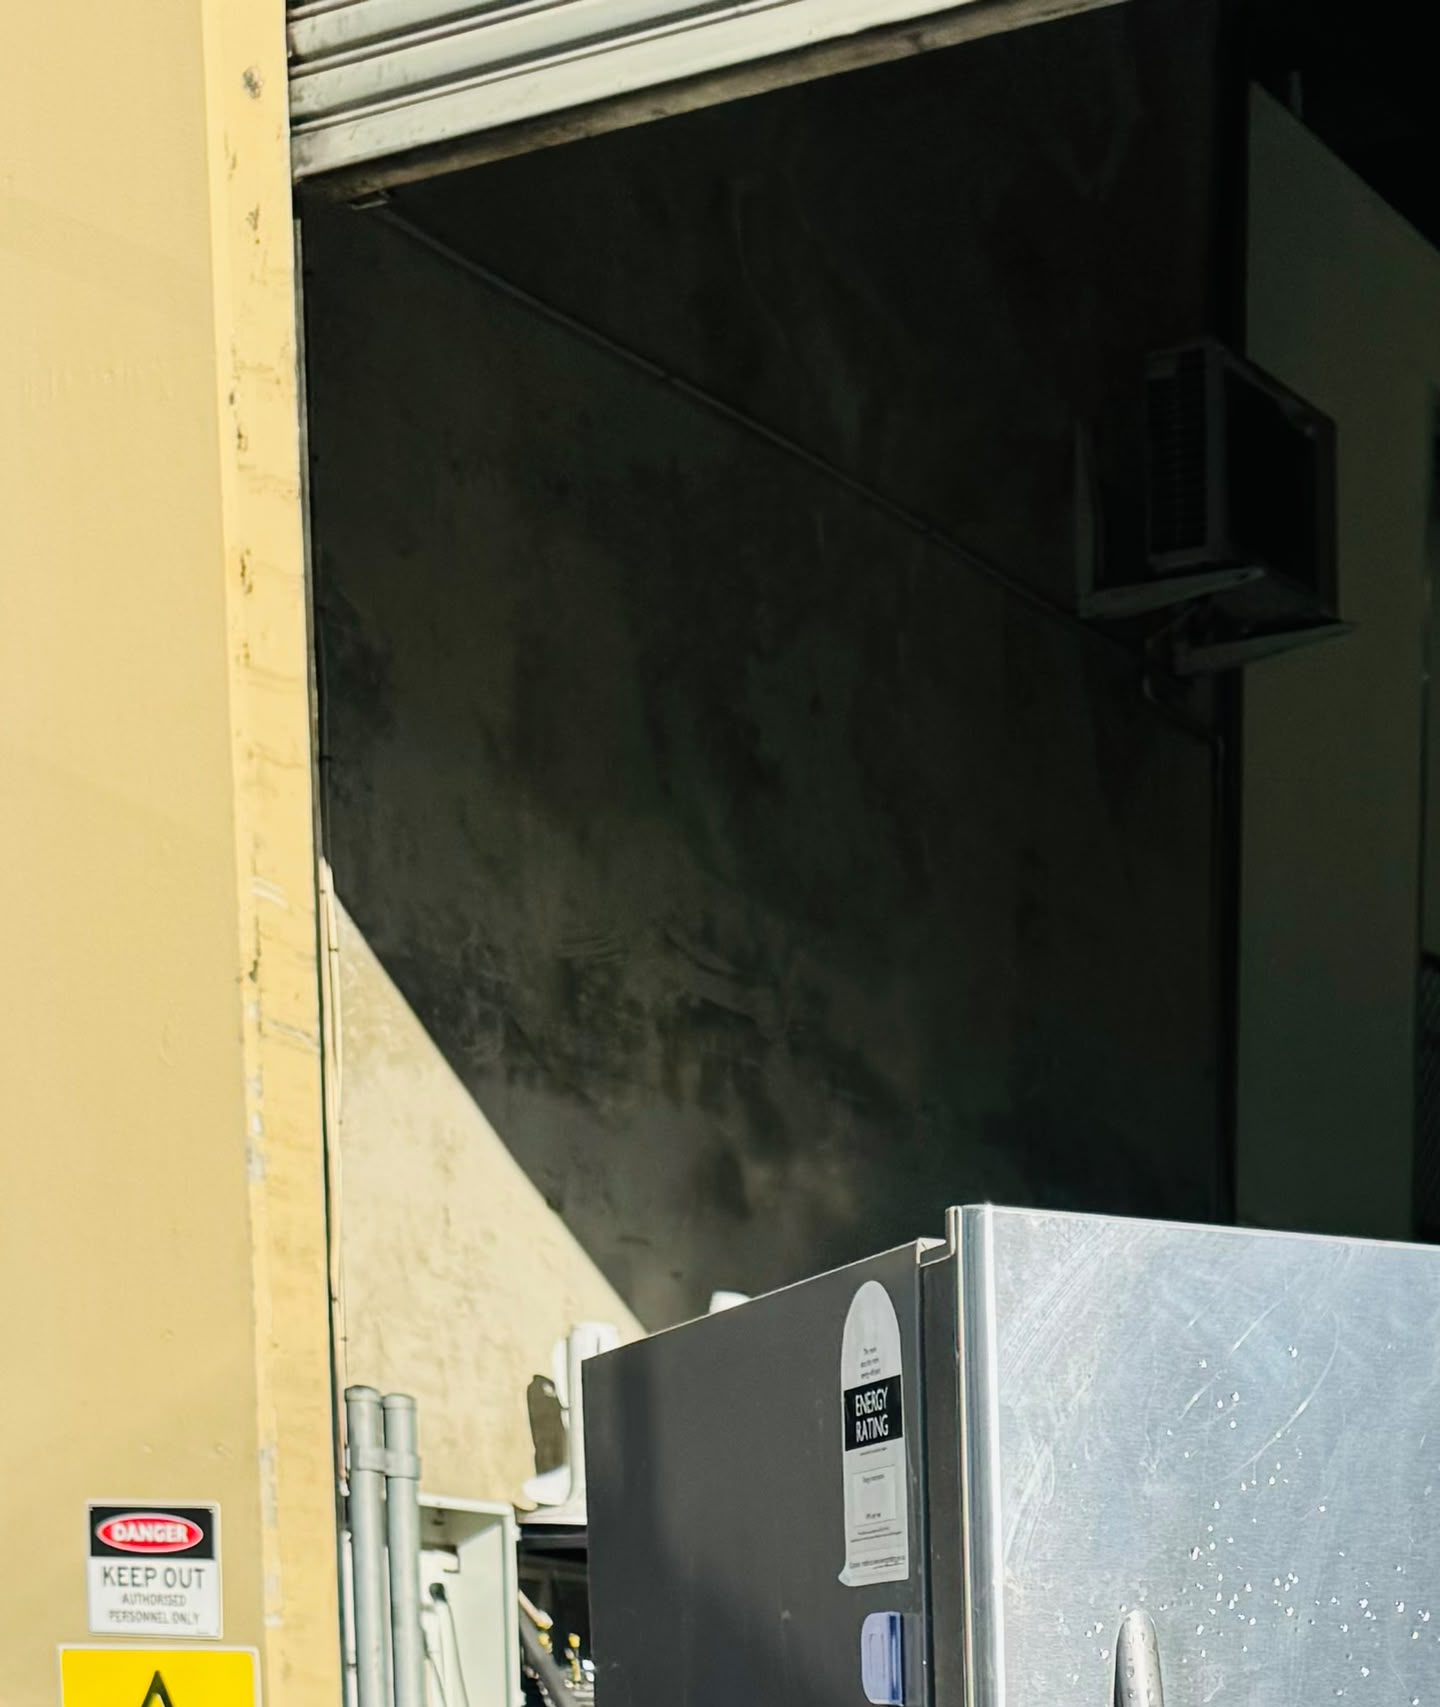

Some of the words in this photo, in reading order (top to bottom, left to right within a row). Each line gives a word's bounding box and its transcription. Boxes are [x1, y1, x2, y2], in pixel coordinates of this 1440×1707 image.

[855, 1386, 889, 1417] ENERGY
[855, 1413, 889, 1443] RATING
[111, 1522, 189, 1543] DANGER
[102, 1565, 157, 1588] KEEP
[163, 1567, 206, 1589] OUT
[122, 1593, 187, 1607] AUTHORISED
[109, 1610, 169, 1624] PERSONNEL
[172, 1612, 200, 1625] ONLY
